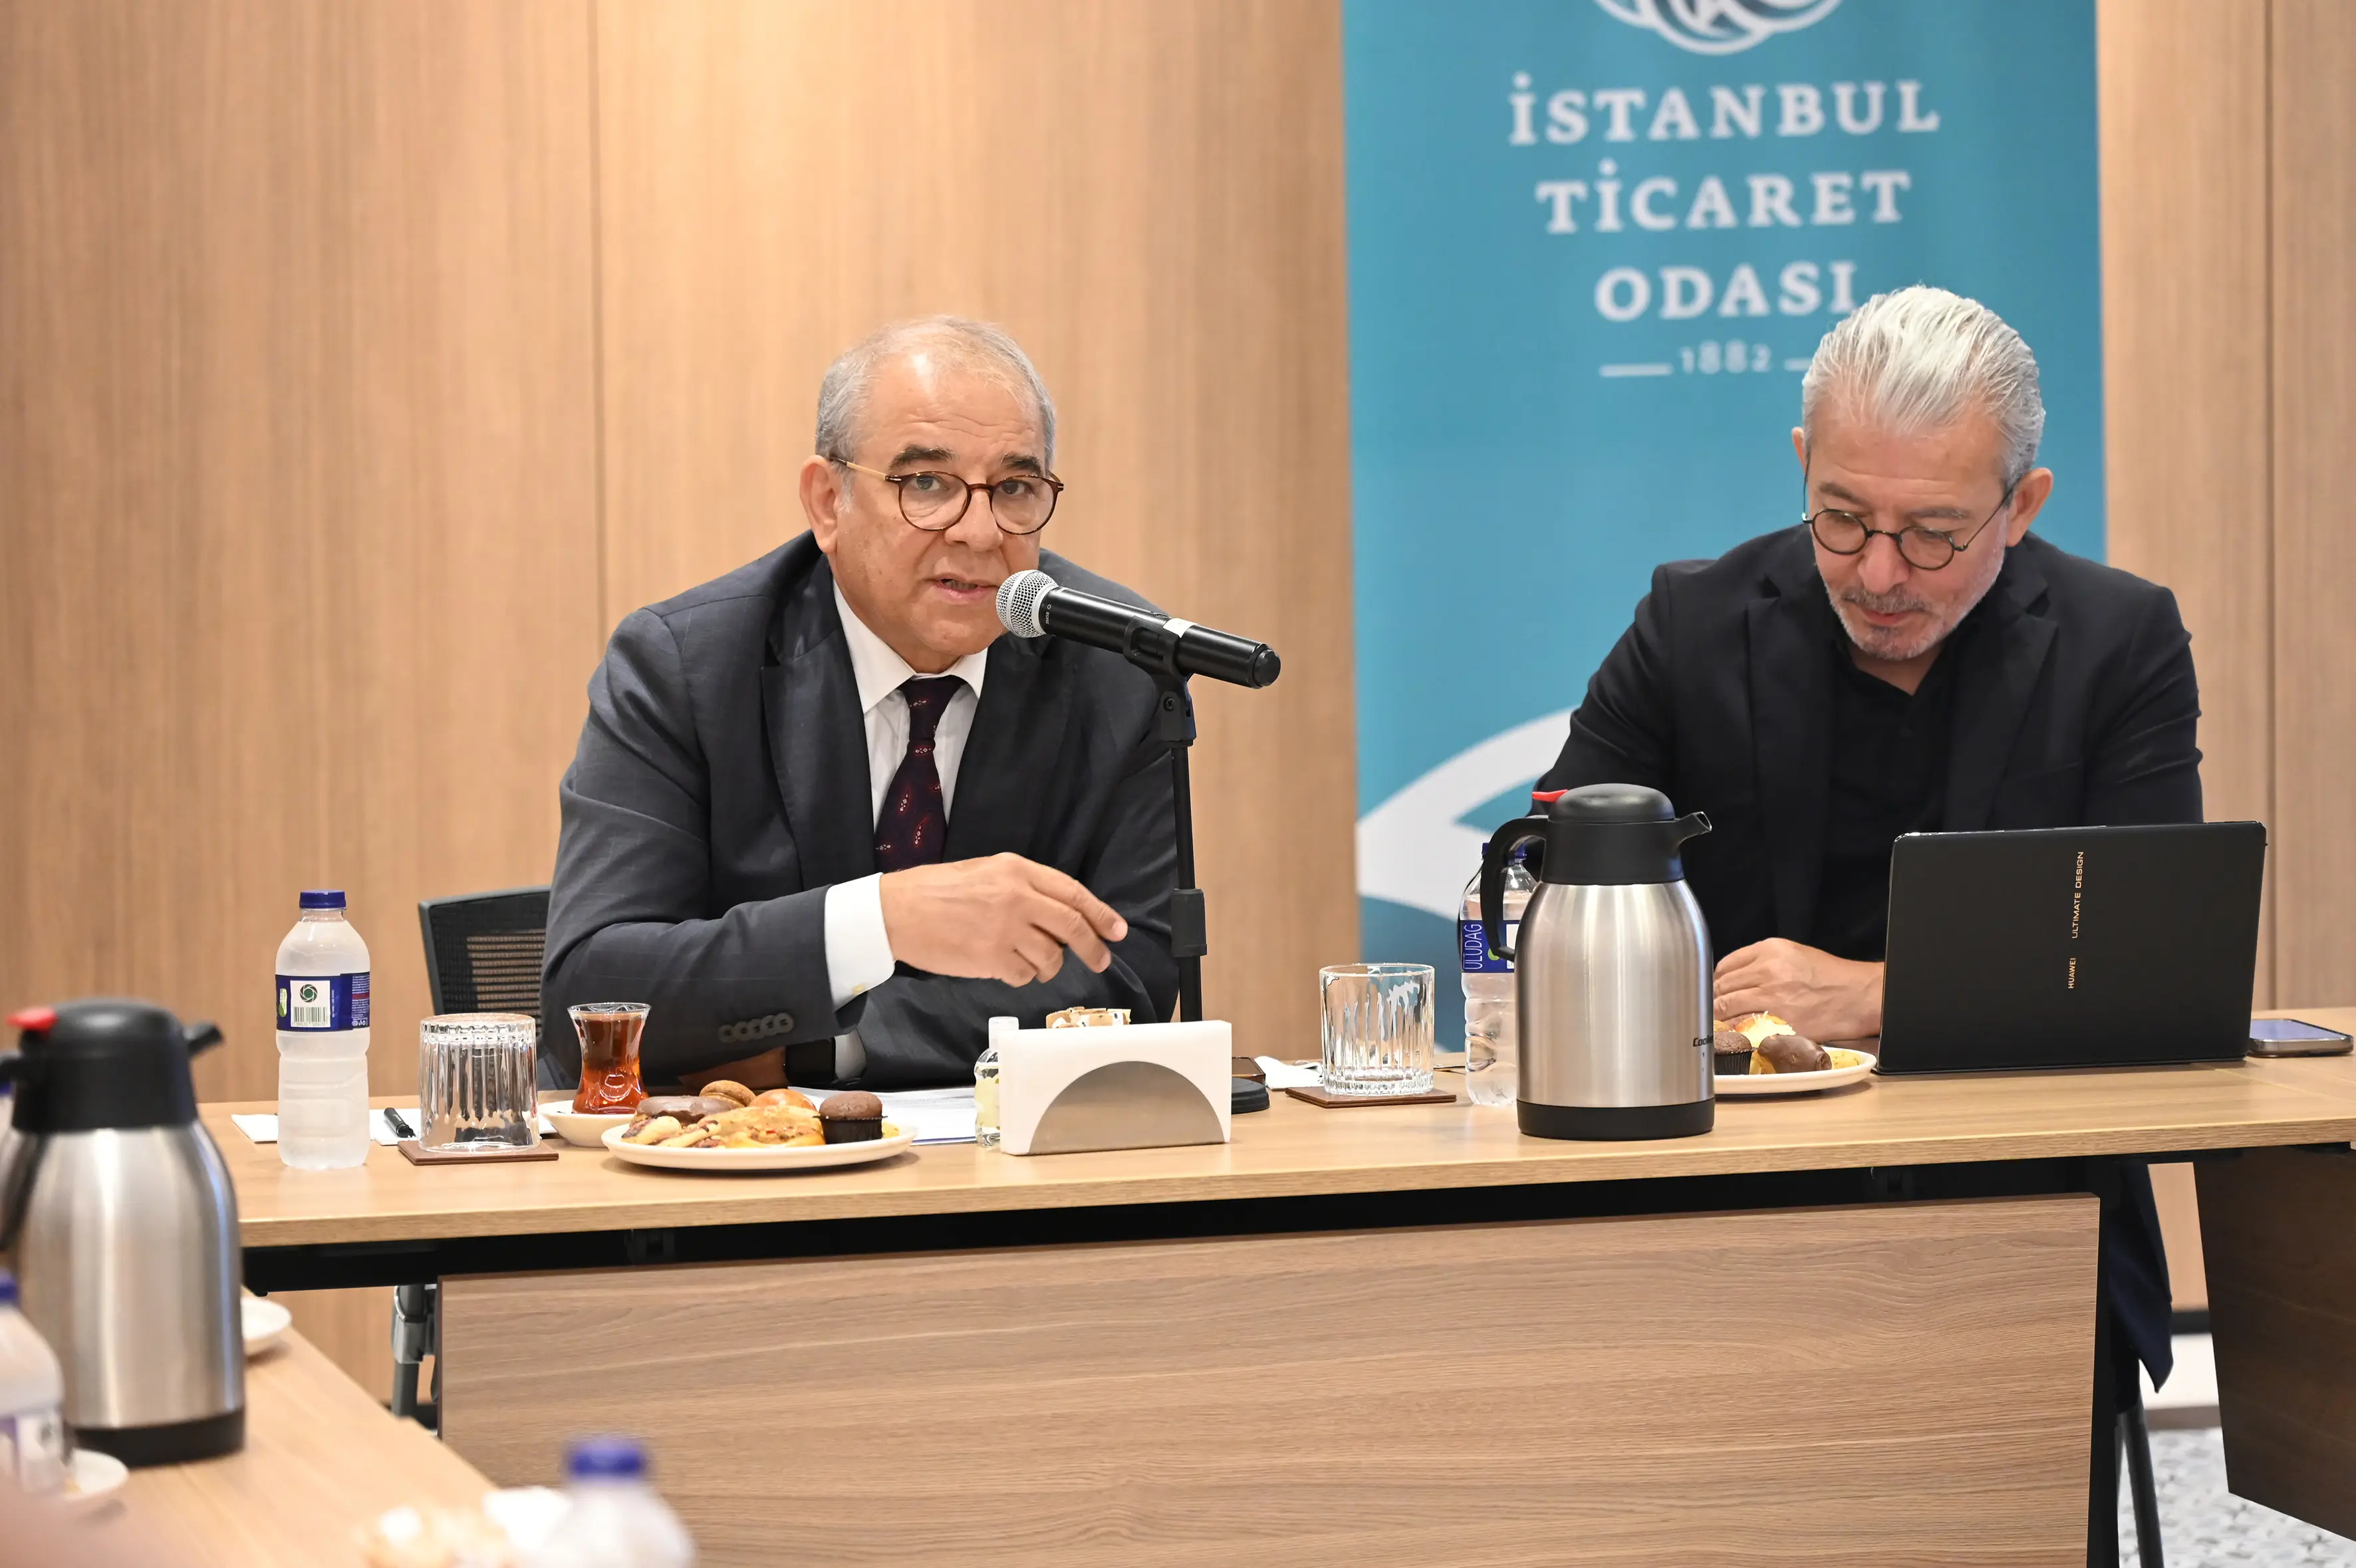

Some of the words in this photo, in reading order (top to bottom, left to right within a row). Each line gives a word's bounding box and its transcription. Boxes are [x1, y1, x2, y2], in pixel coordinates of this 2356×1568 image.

[1509, 71, 1940, 146] İSTANBUL
[1535, 157, 1911, 235] TİCARET
[1594, 260, 1857, 323] ODASI
[1678, 339, 1772, 375] 1882
[2075, 851, 2084, 889] DESIGN
[2071, 892, 2081, 939] ULTIMATE
[1463, 924, 1483, 970] ULUDAĞ
[2067, 958, 2076, 989] HUAWEI
